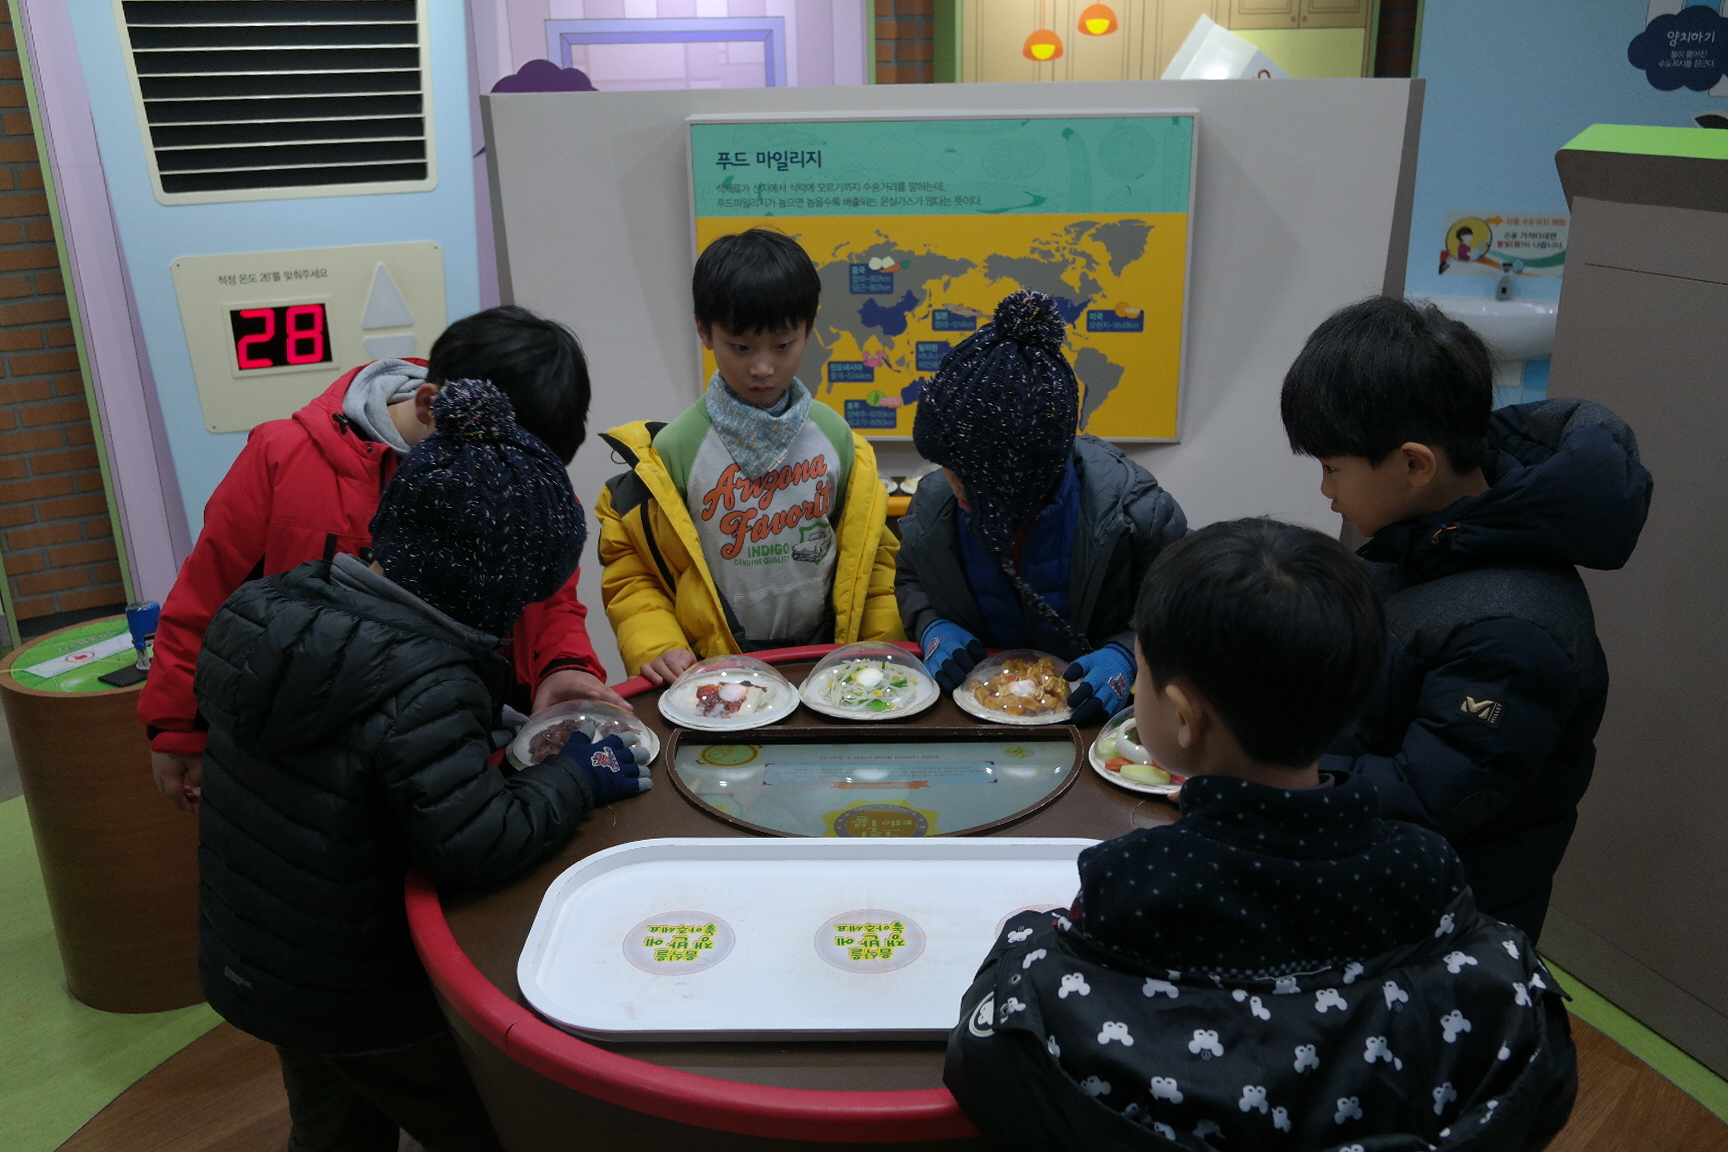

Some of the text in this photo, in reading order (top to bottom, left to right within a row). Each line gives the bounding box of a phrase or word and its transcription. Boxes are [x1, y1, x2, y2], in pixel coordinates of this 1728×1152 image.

[1667, 30, 1716, 48] 양치하기
[715, 150, 822, 172] 푸드 마일리지
[716, 184, 751, 194] 식재료가
[753, 184, 787, 194] 산지에서
[789, 183, 815, 193] 식탁에
[818, 182, 861, 193] 오르기까지
[863, 181, 906, 192] 수송거리를
[716, 198, 776, 208] 푸드마일리지가
[778, 198, 804, 208] 높으면
[806, 197, 841, 208] 높을수록
[843, 196, 877, 207] 배출되는
[880, 196, 923, 207] 온실가스가
[925, 196, 951, 207] 많다는
[217, 275, 237, 286] 적정
[239, 274, 257, 285] 온도
[283, 268, 329, 281] 맞춰주세요
[1089, 312, 1104, 321] 미국
[237, 304, 324, 370] 28
[917, 344, 938, 352] 필리핀
[702, 454, 828, 521] Arizona
[747, 543, 790, 558] INDIGO
[734, 558, 763, 566] GENUINE
[647, 923, 716, 936] 놓아주세요
[834, 921, 904, 934] 놓아주세요
[654, 948, 699, 961] 음식을
[848, 947, 893, 960] 음식을
